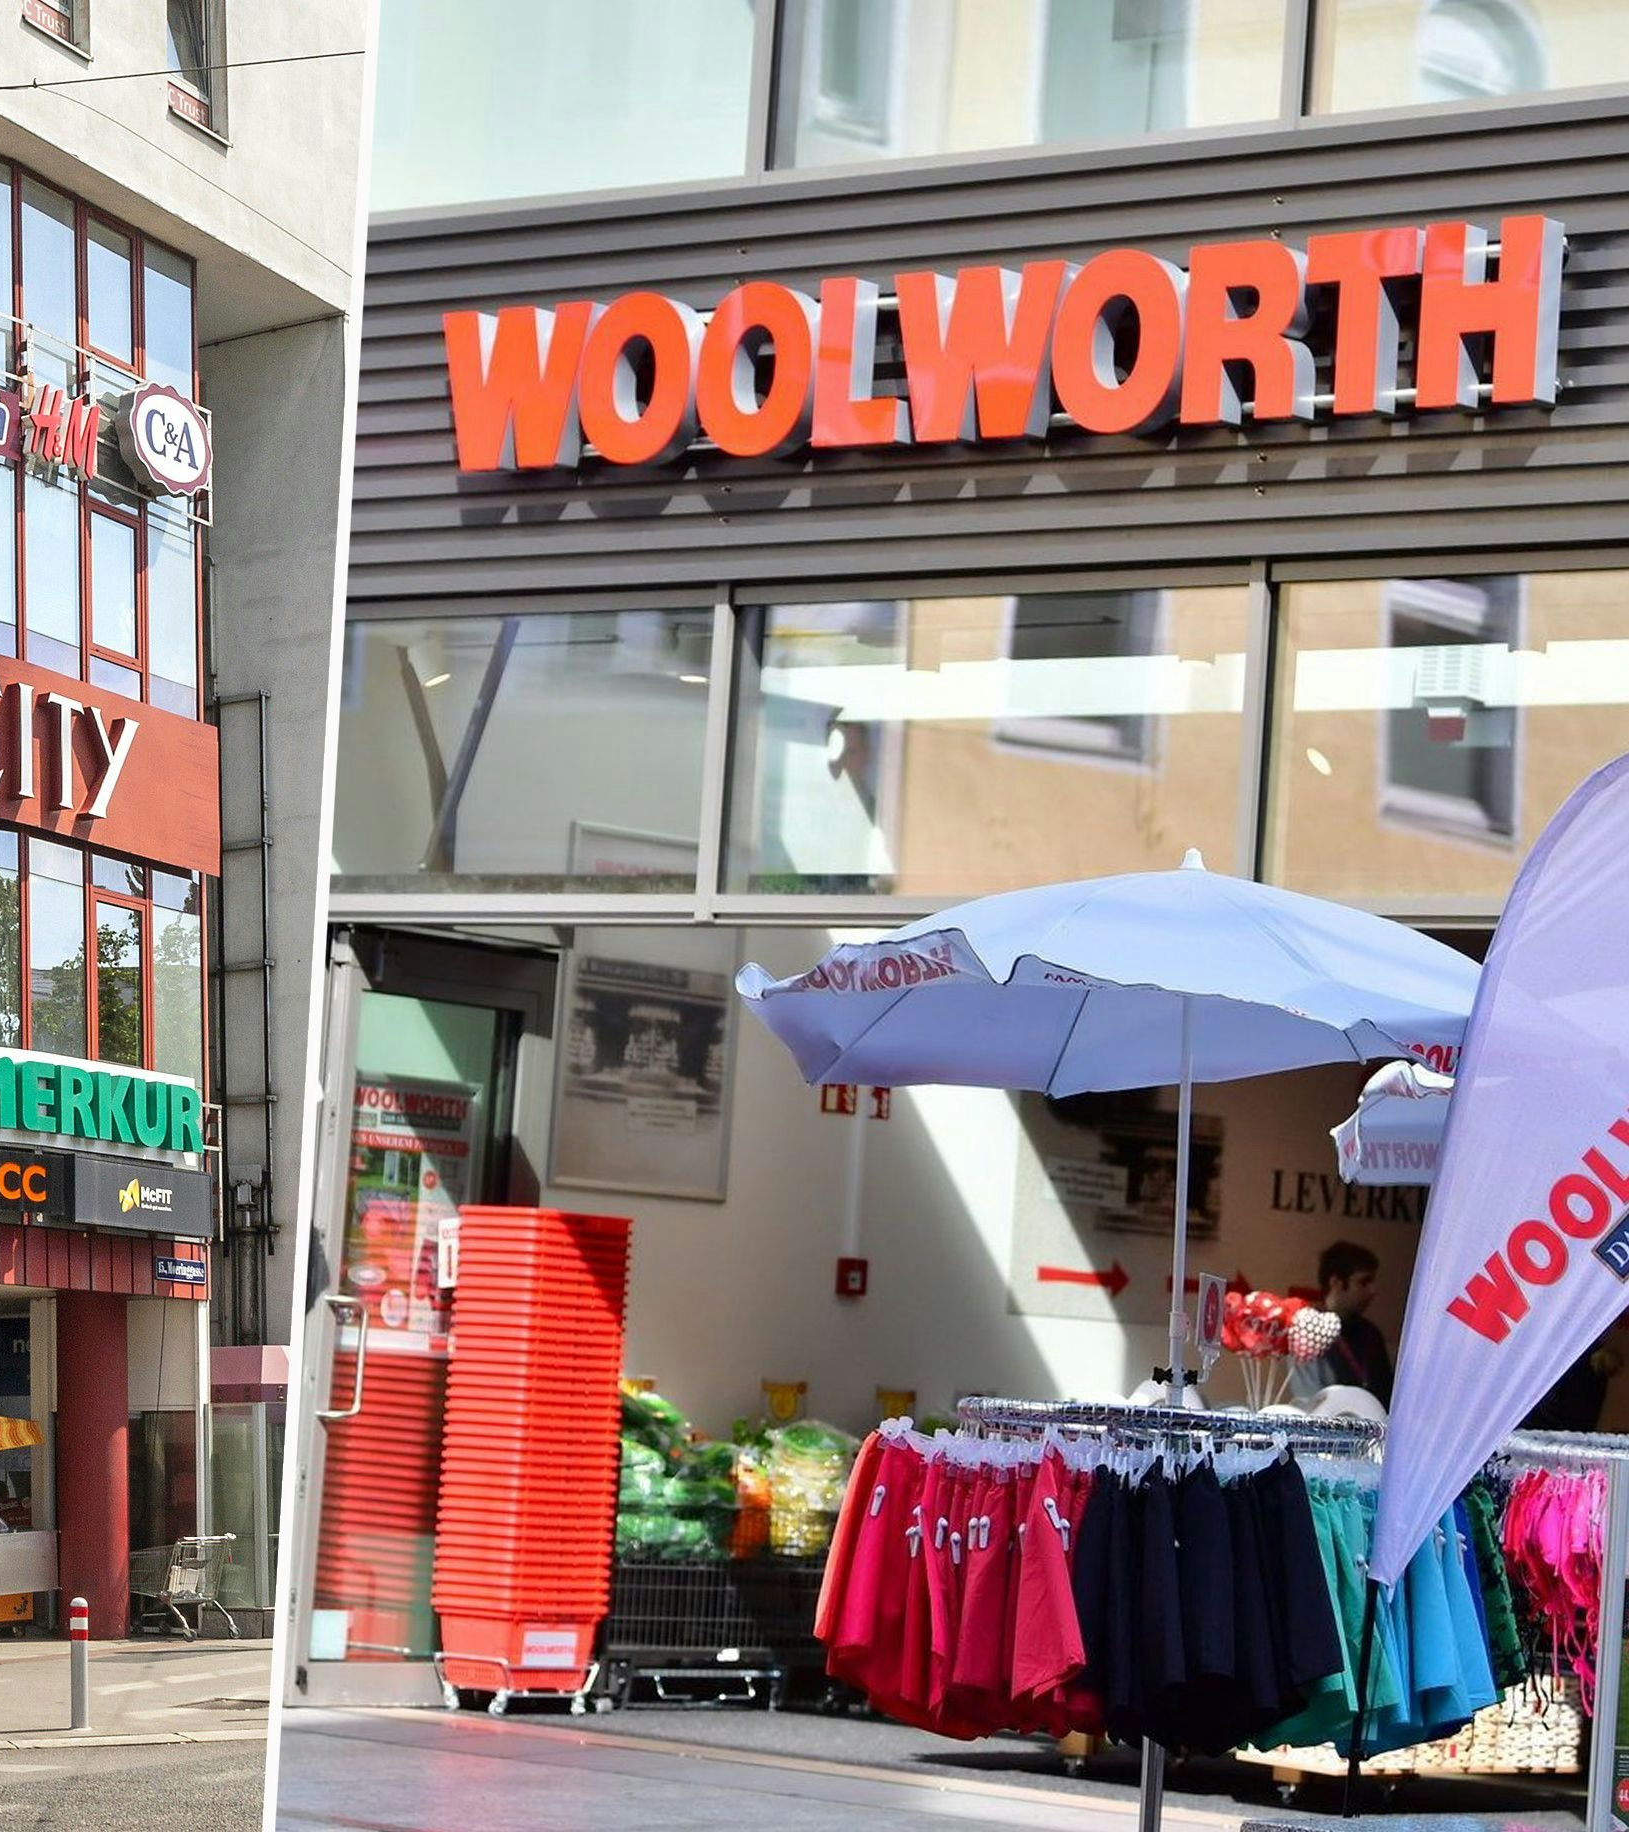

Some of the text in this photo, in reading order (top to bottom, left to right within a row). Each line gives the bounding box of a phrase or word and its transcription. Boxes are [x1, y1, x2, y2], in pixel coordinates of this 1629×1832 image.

[34, 2, 67, 37] Trust
[177, 93, 206, 124] Trust
[441, 215, 1563, 473] WOOLWORTH
[27, 383, 100, 482] H&M
[146, 408, 201, 471] C&A
[1445, 1104, 1629, 1345] WOOL
